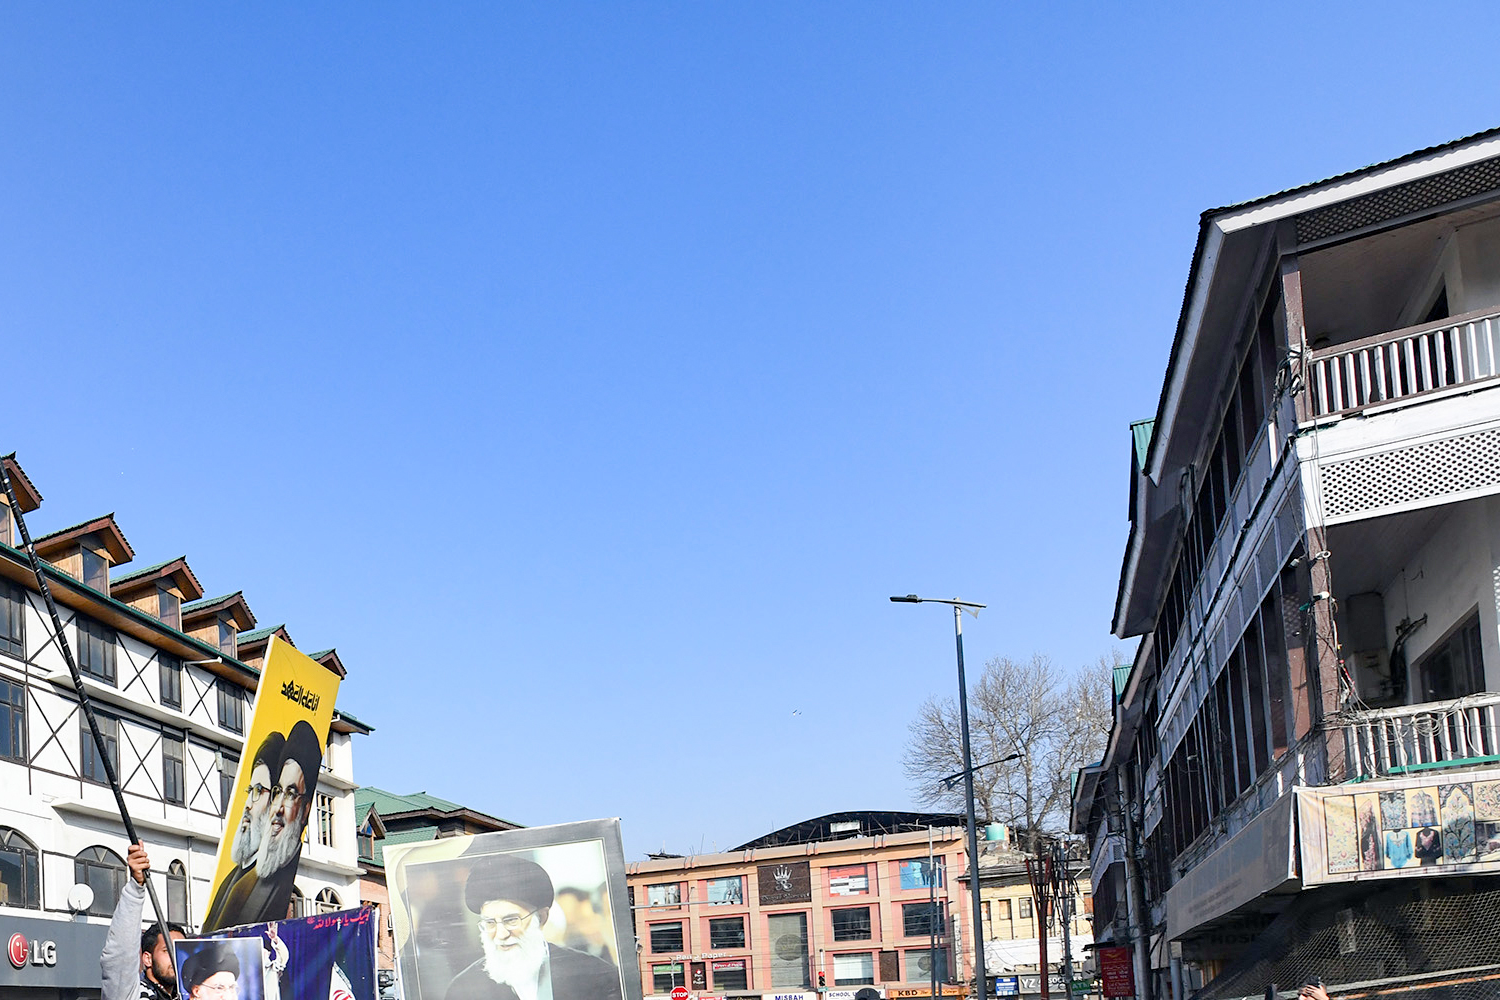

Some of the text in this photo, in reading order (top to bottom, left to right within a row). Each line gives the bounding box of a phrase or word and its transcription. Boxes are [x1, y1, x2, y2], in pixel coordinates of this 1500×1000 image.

[33, 940, 57, 965] LG
[1021, 978, 1036, 988] YZ
[897, 989, 918, 997] KBD
